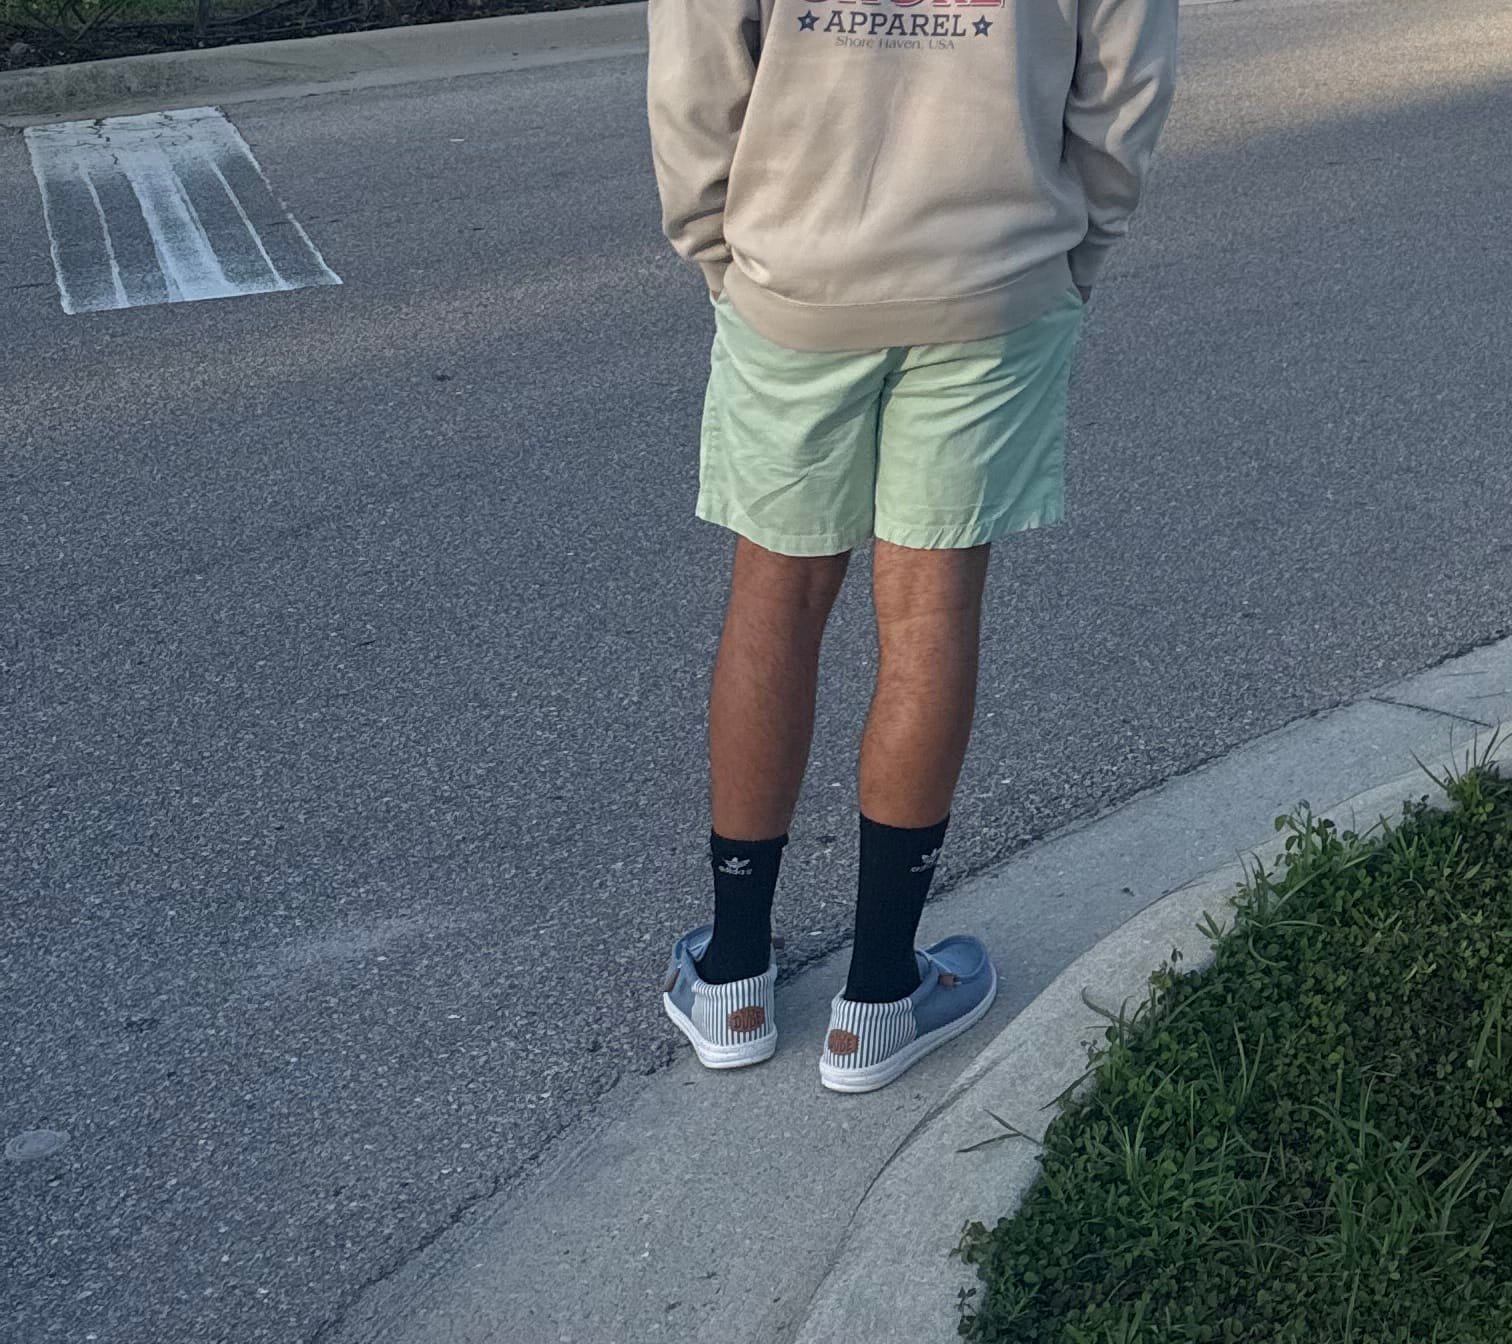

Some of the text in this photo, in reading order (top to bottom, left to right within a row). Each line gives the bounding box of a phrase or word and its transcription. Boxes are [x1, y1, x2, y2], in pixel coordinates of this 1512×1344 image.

[823, 10, 967, 37] APPAREL
[835, 35, 874, 49] Shore
[928, 39, 955, 50] USA
